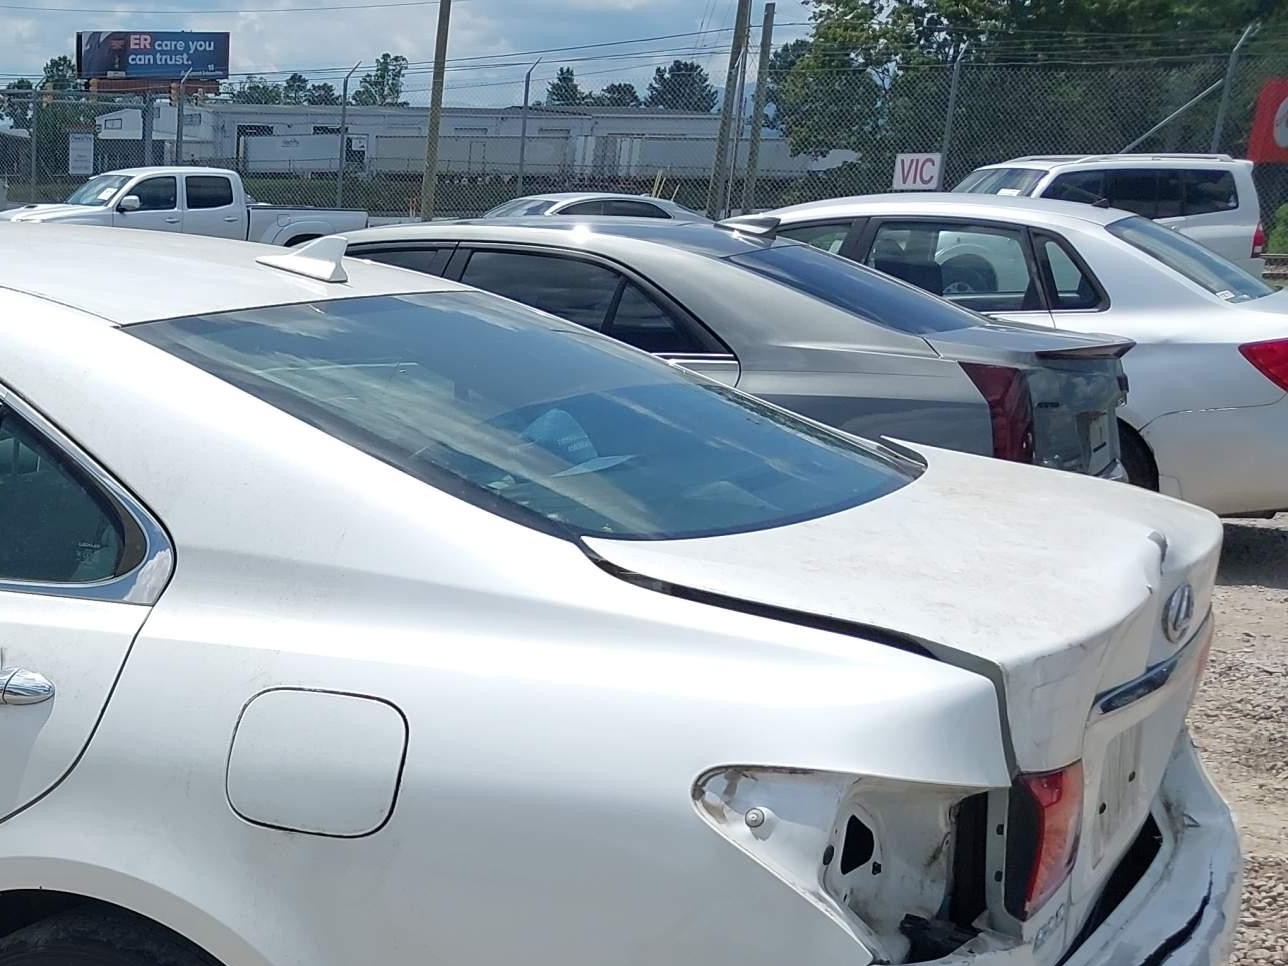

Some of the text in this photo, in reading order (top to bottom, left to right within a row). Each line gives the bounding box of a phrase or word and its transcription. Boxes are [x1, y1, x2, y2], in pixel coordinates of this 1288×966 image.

[130, 35, 152, 49] ER
[154, 40, 185, 51] care
[189, 40, 215, 53] you
[128, 53, 192, 65] can trust.
[900, 157, 936, 185] VIC
